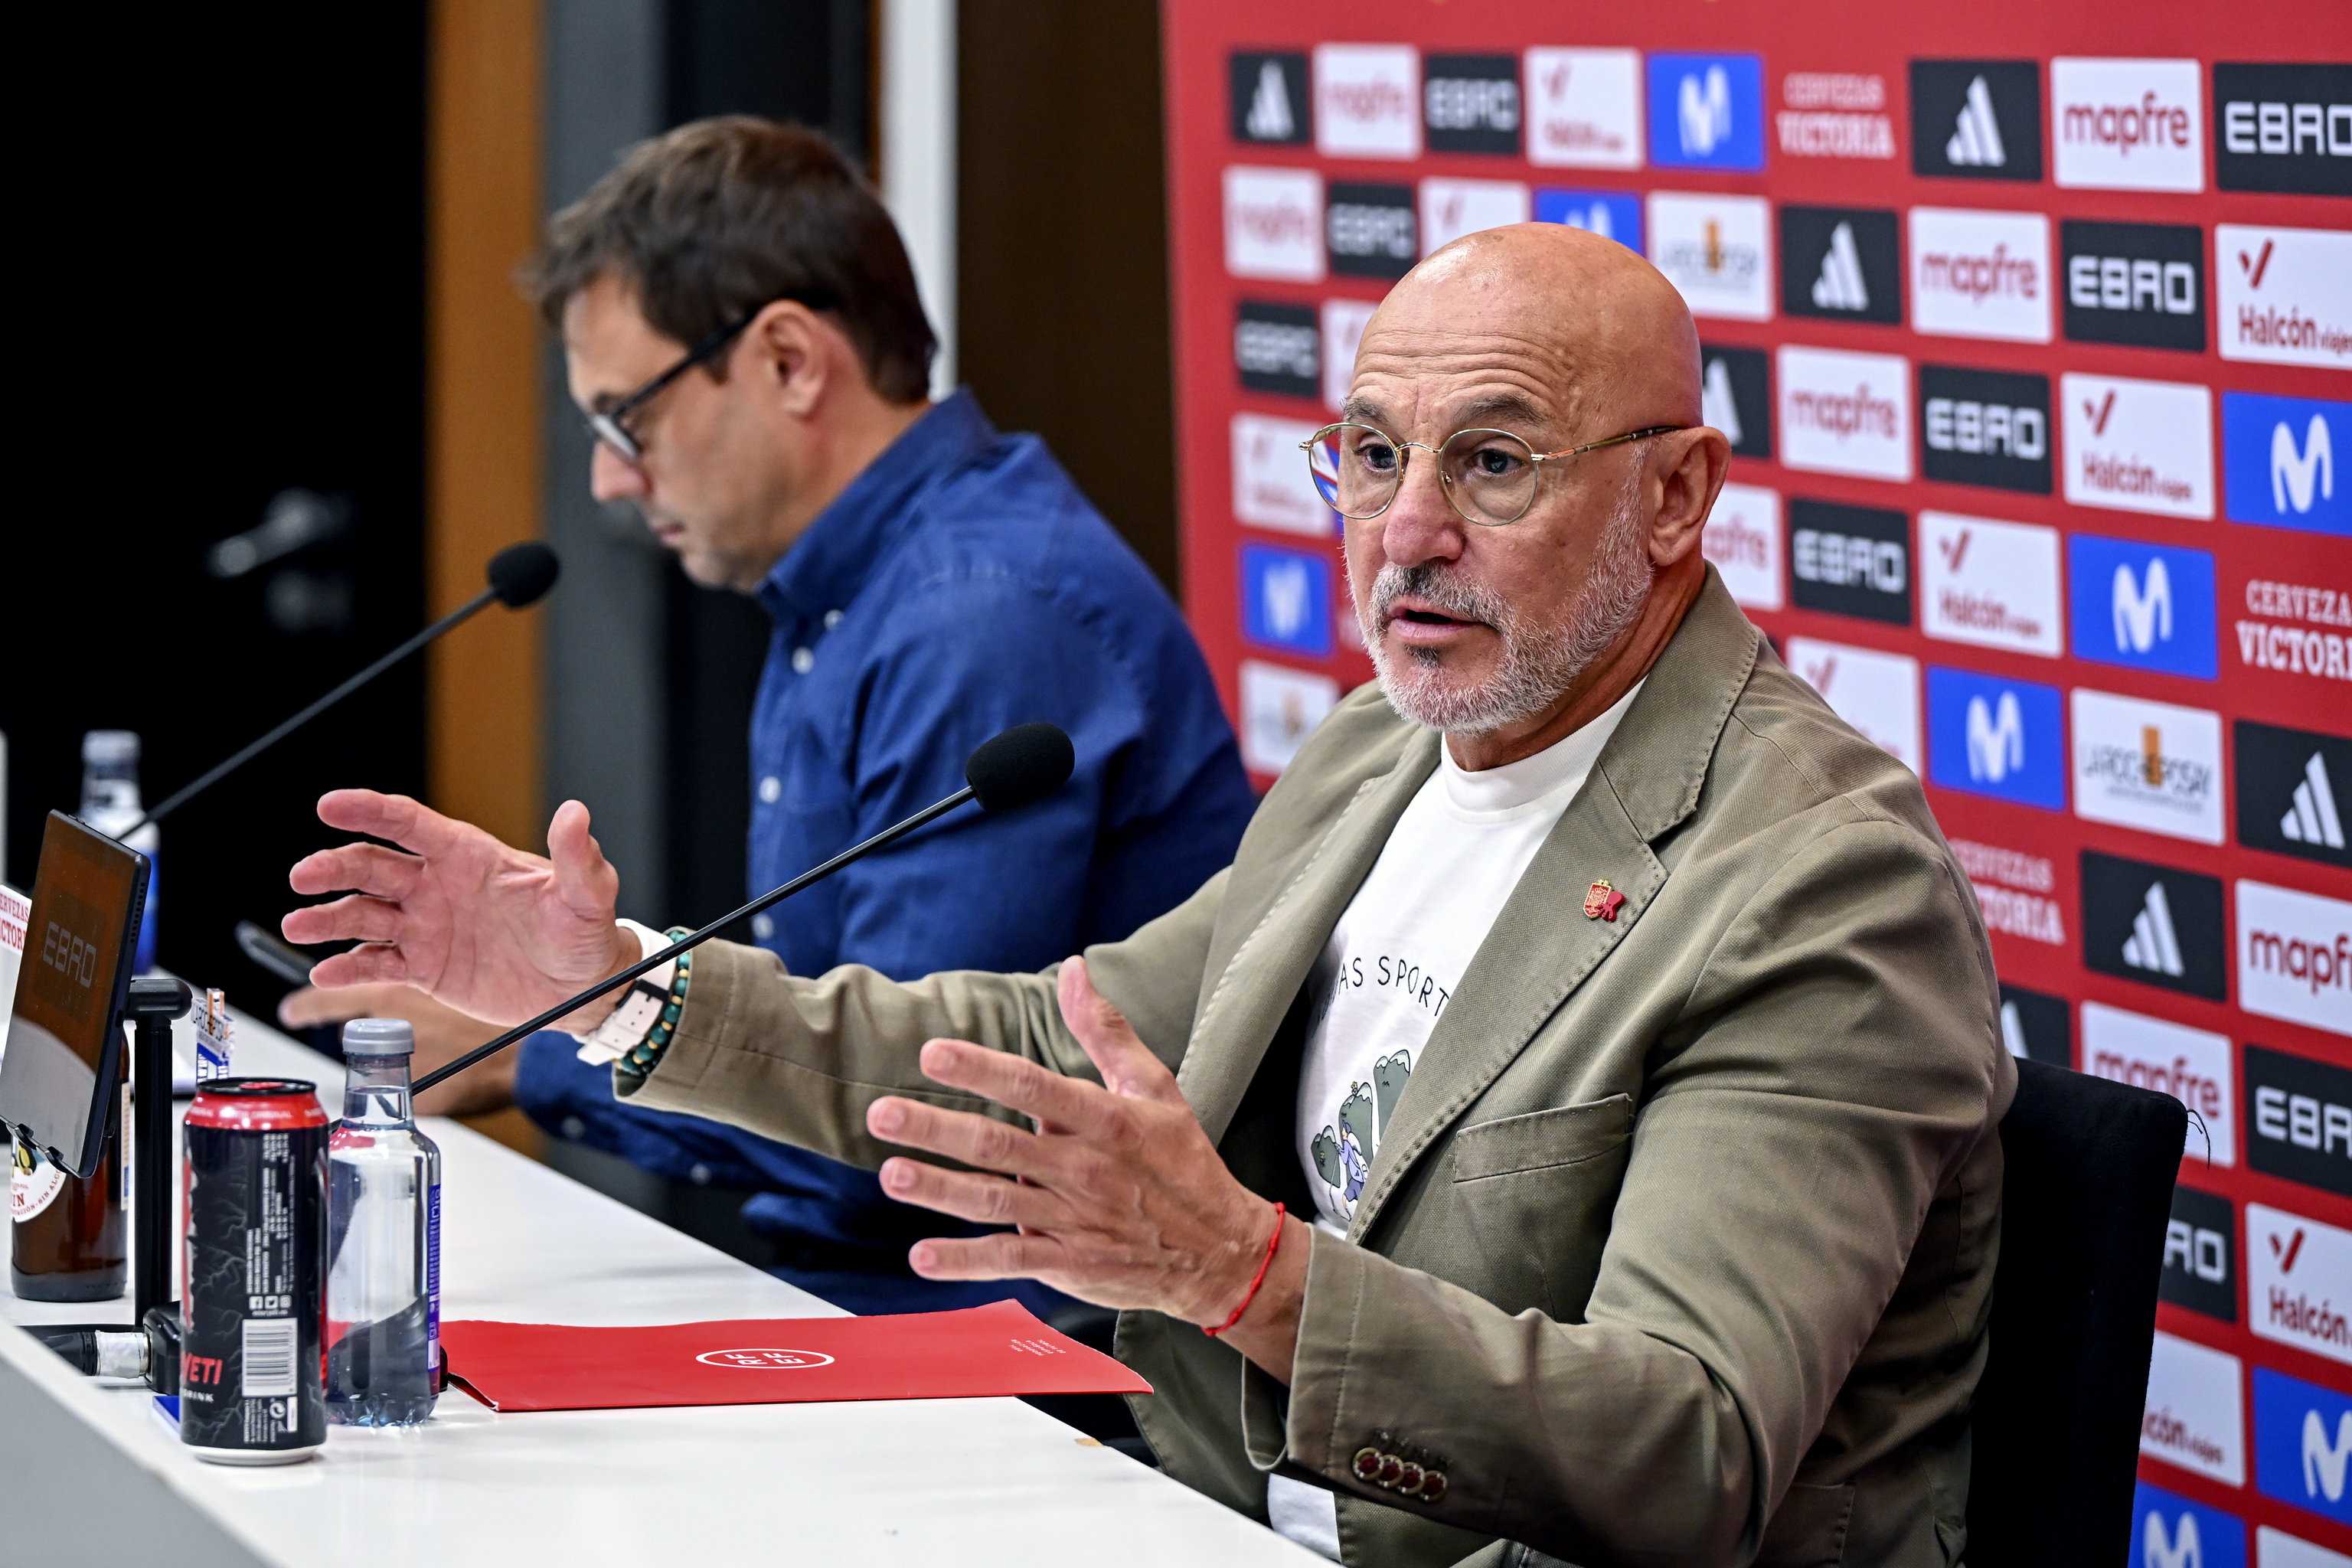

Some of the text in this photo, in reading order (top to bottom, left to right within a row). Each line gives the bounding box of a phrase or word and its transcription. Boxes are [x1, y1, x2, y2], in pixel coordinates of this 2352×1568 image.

[2064, 90, 2190, 155] mapfre
[2225, 101, 2352, 156] EBRO
[1920, 241, 2038, 305] mapfre
[2069, 254, 2196, 315] EBRO
[2239, 305, 2317, 348] Halcón
[1925, 397, 2046, 460] EBRO
[2246, 580, 2352, 627] CERVEZA
[0, 893, 29, 923] ERVEZAS
[43, 921, 96, 988] EBRO
[2249, 929, 2352, 995] mapf
[2255, 1086, 2352, 1160] EBR
[2269, 1285, 2347, 1347] Halcón
